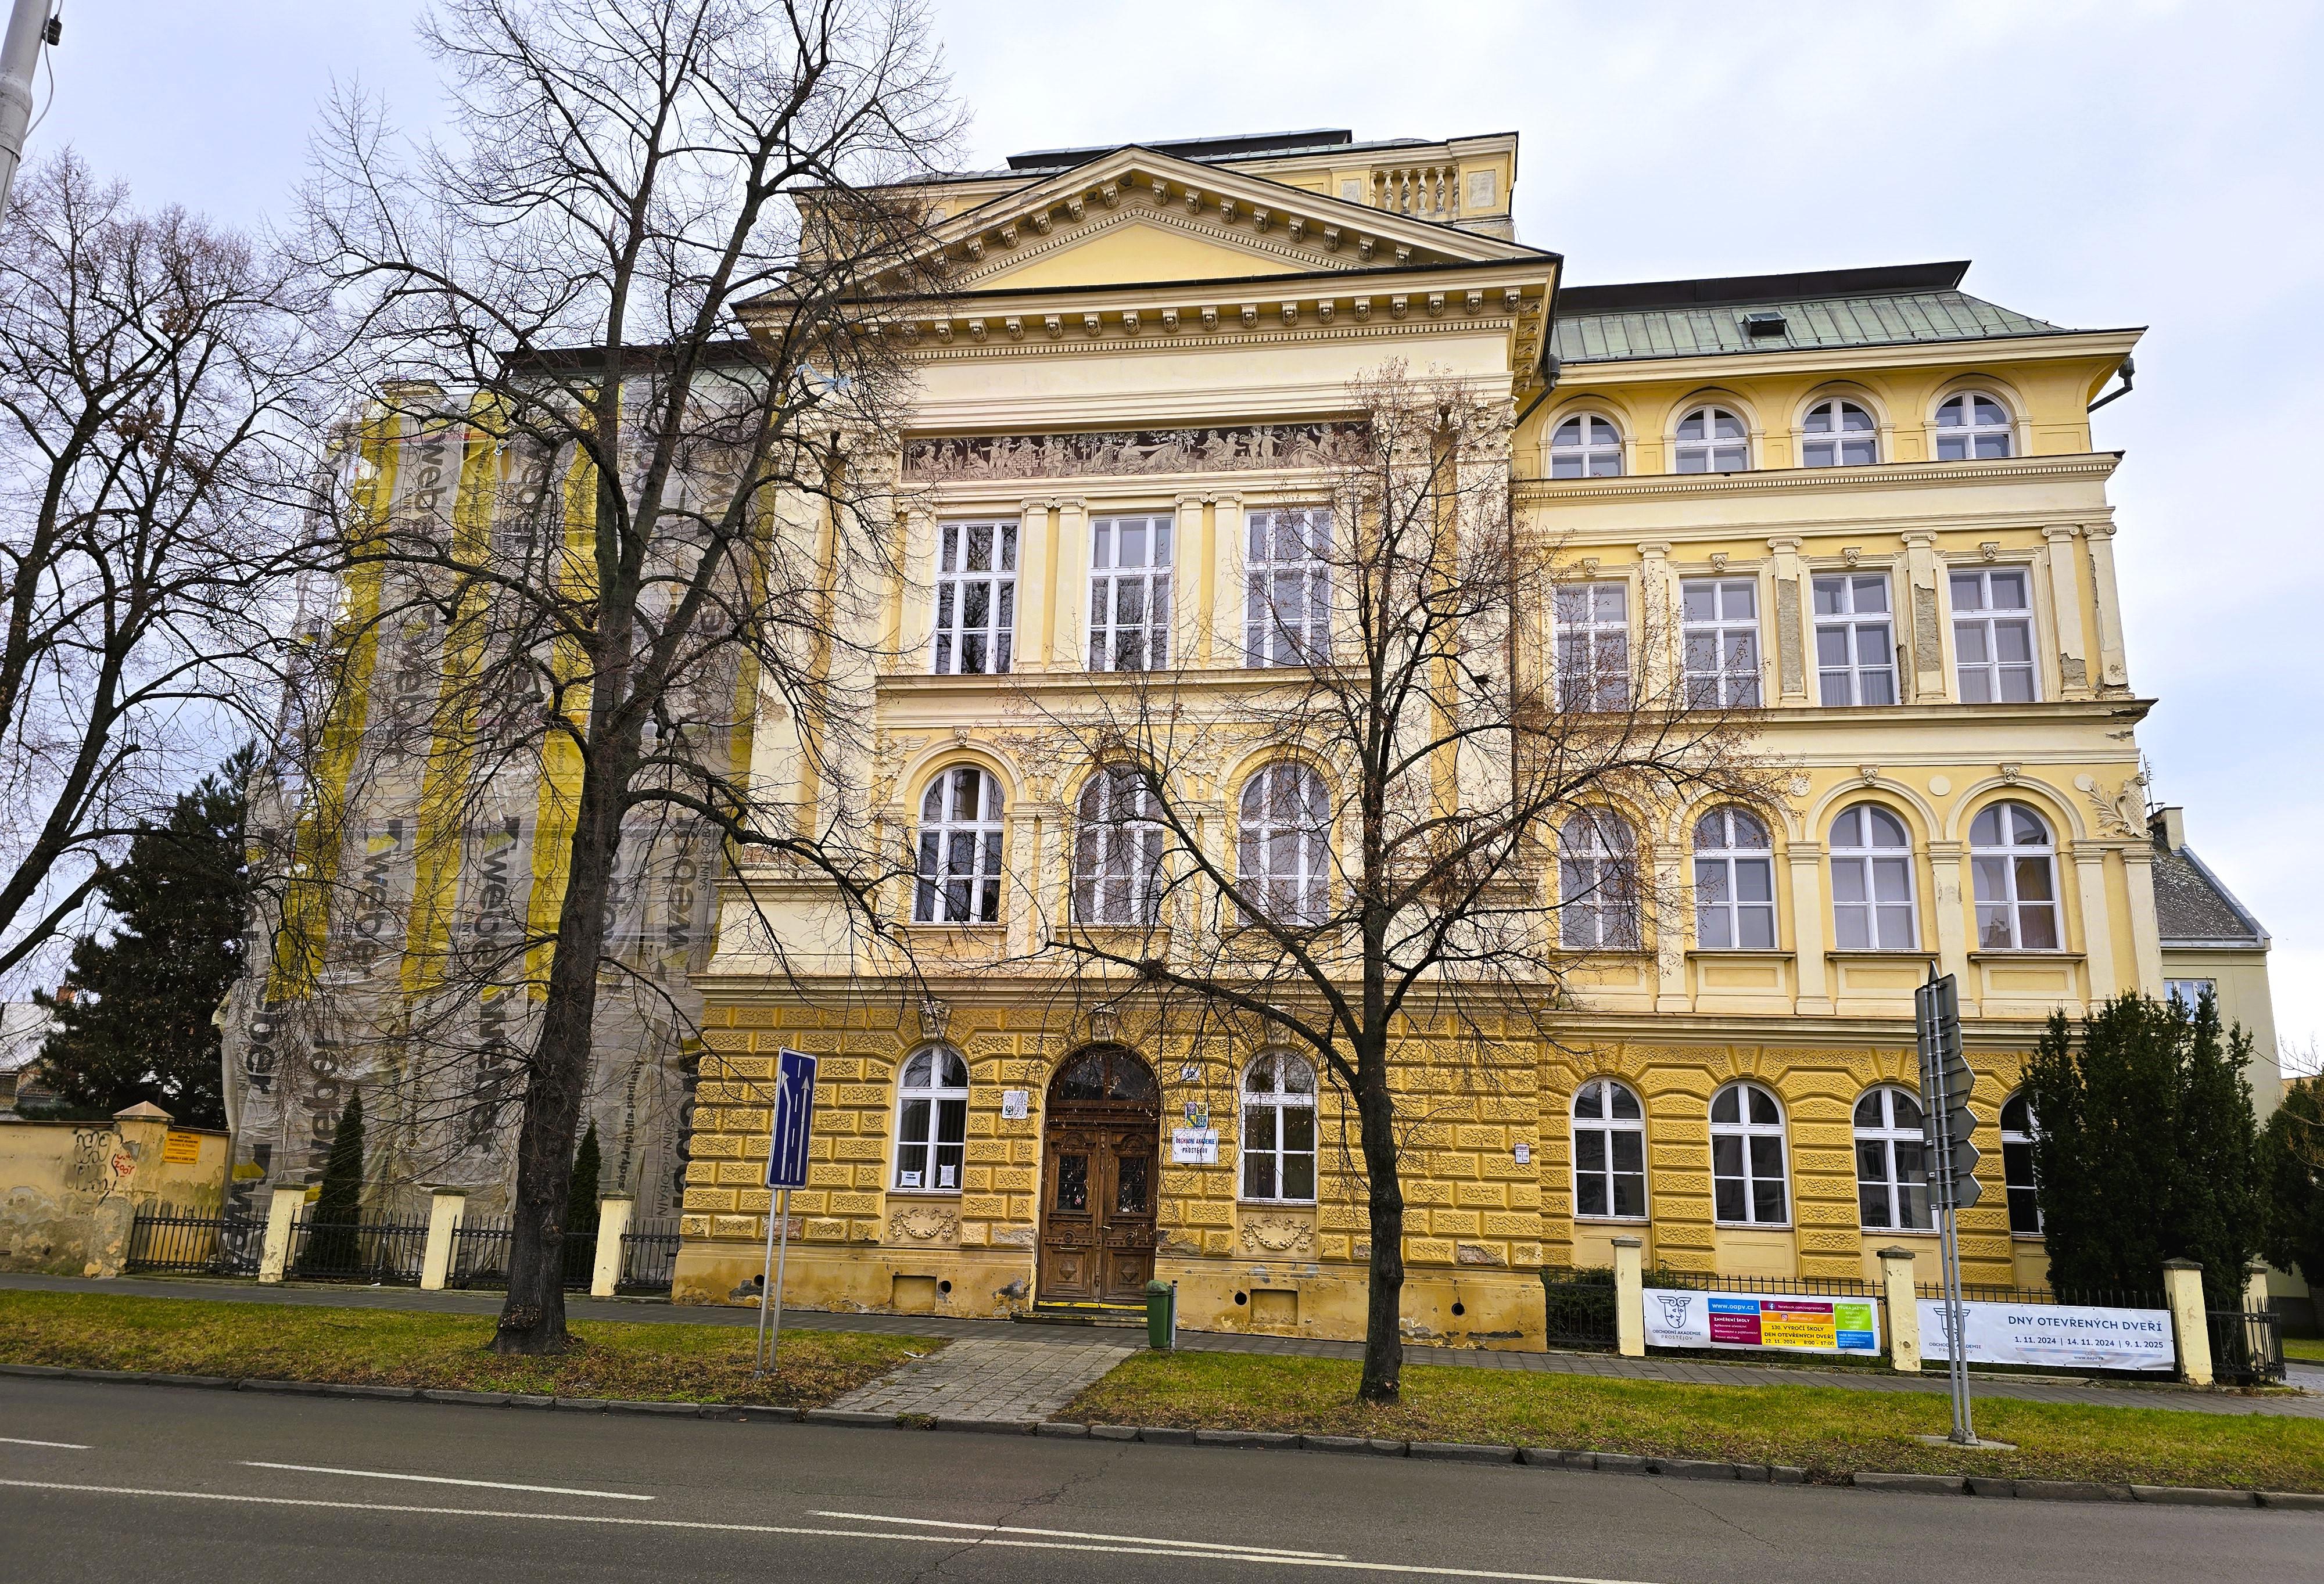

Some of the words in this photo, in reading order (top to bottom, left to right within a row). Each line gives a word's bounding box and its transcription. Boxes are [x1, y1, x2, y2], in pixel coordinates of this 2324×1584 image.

[354, 851, 392, 980] weber
[662, 811, 699, 950] weber
[656, 1120, 675, 1218] SAINT-GOBAIN
[2009, 1316, 2033, 1325] DNY
[2038, 1317, 2118, 1330] OTEVŘENÝCH
[2122, 1320, 2162, 1331] DVEŘÍ
